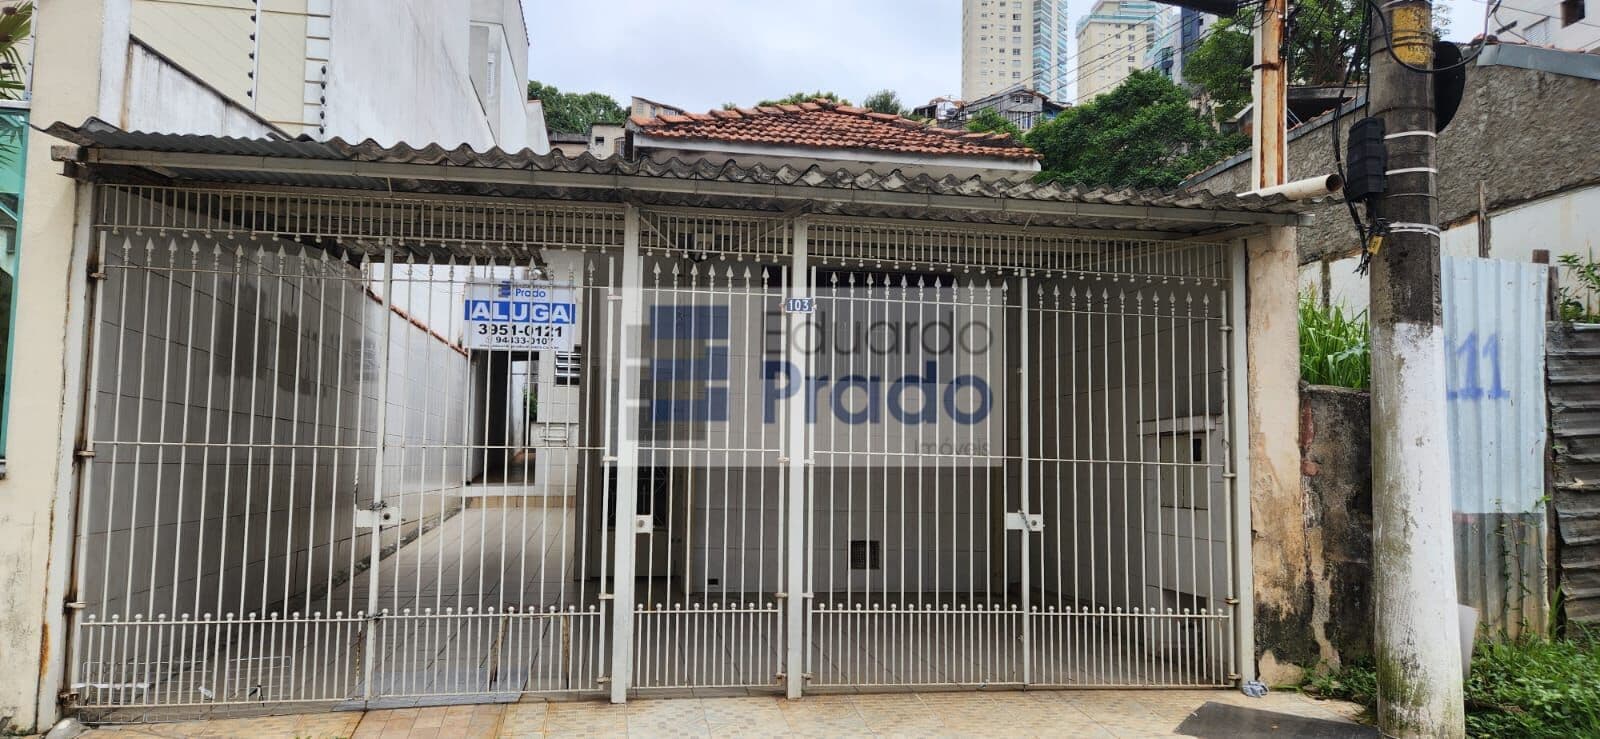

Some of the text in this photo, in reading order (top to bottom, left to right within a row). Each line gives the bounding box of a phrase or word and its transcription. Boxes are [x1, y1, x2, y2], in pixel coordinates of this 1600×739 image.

[515, 288, 546, 298] Prado
[788, 299, 809, 311] 103
[472, 302, 570, 322] ALUGA
[478, 323, 562, 337] 3951-0121
